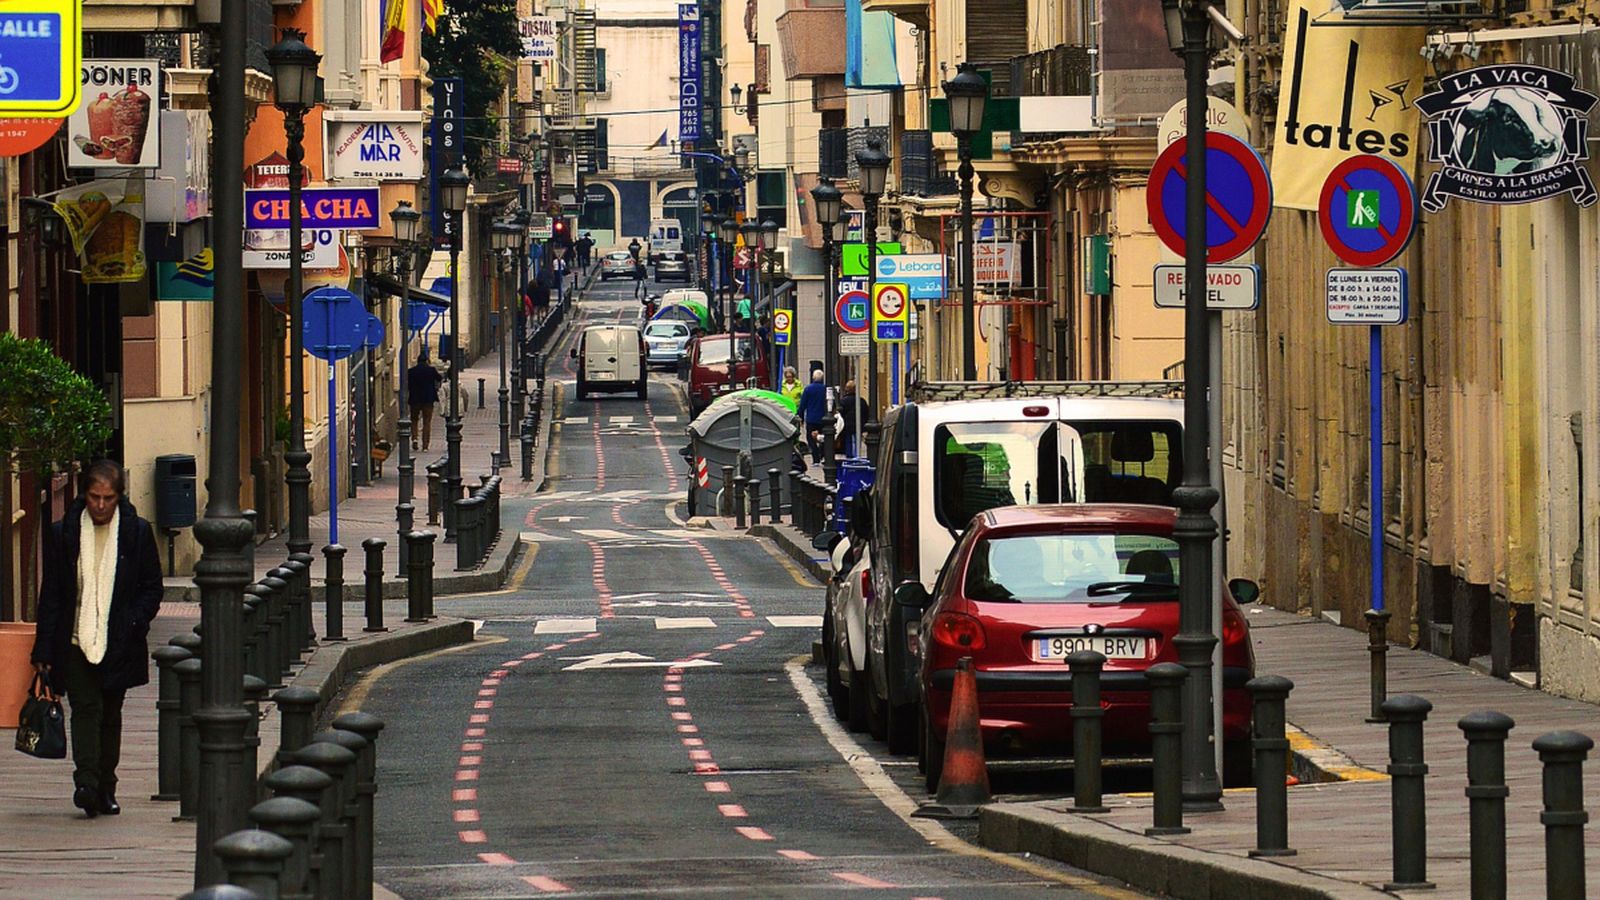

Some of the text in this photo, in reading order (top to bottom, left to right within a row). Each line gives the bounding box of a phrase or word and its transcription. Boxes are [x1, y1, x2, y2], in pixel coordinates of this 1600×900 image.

[0, 19, 52, 38] ALLE
[522, 20, 554, 36] HOSTAL
[524, 47, 554, 57] ernando
[1453, 69, 1549, 91] LA VACA
[682, 78, 697, 107] BDI
[335, 122, 368, 158] ACADEMIA
[360, 144, 401, 161] MAR
[1444, 165, 1572, 188] CARNES A LA BRASA
[1459, 182, 1561, 199] ESTILO ARGENTINO
[253, 198, 372, 220] CHA CHA
[900, 261, 942, 272] Lebara
[1329, 275, 1338, 283] DE
[1340, 275, 1362, 283] LUNES
[1364, 275, 1369, 283] A
[1053, 638, 1094, 655] 9901
[1105, 638, 1138, 655] BRV
